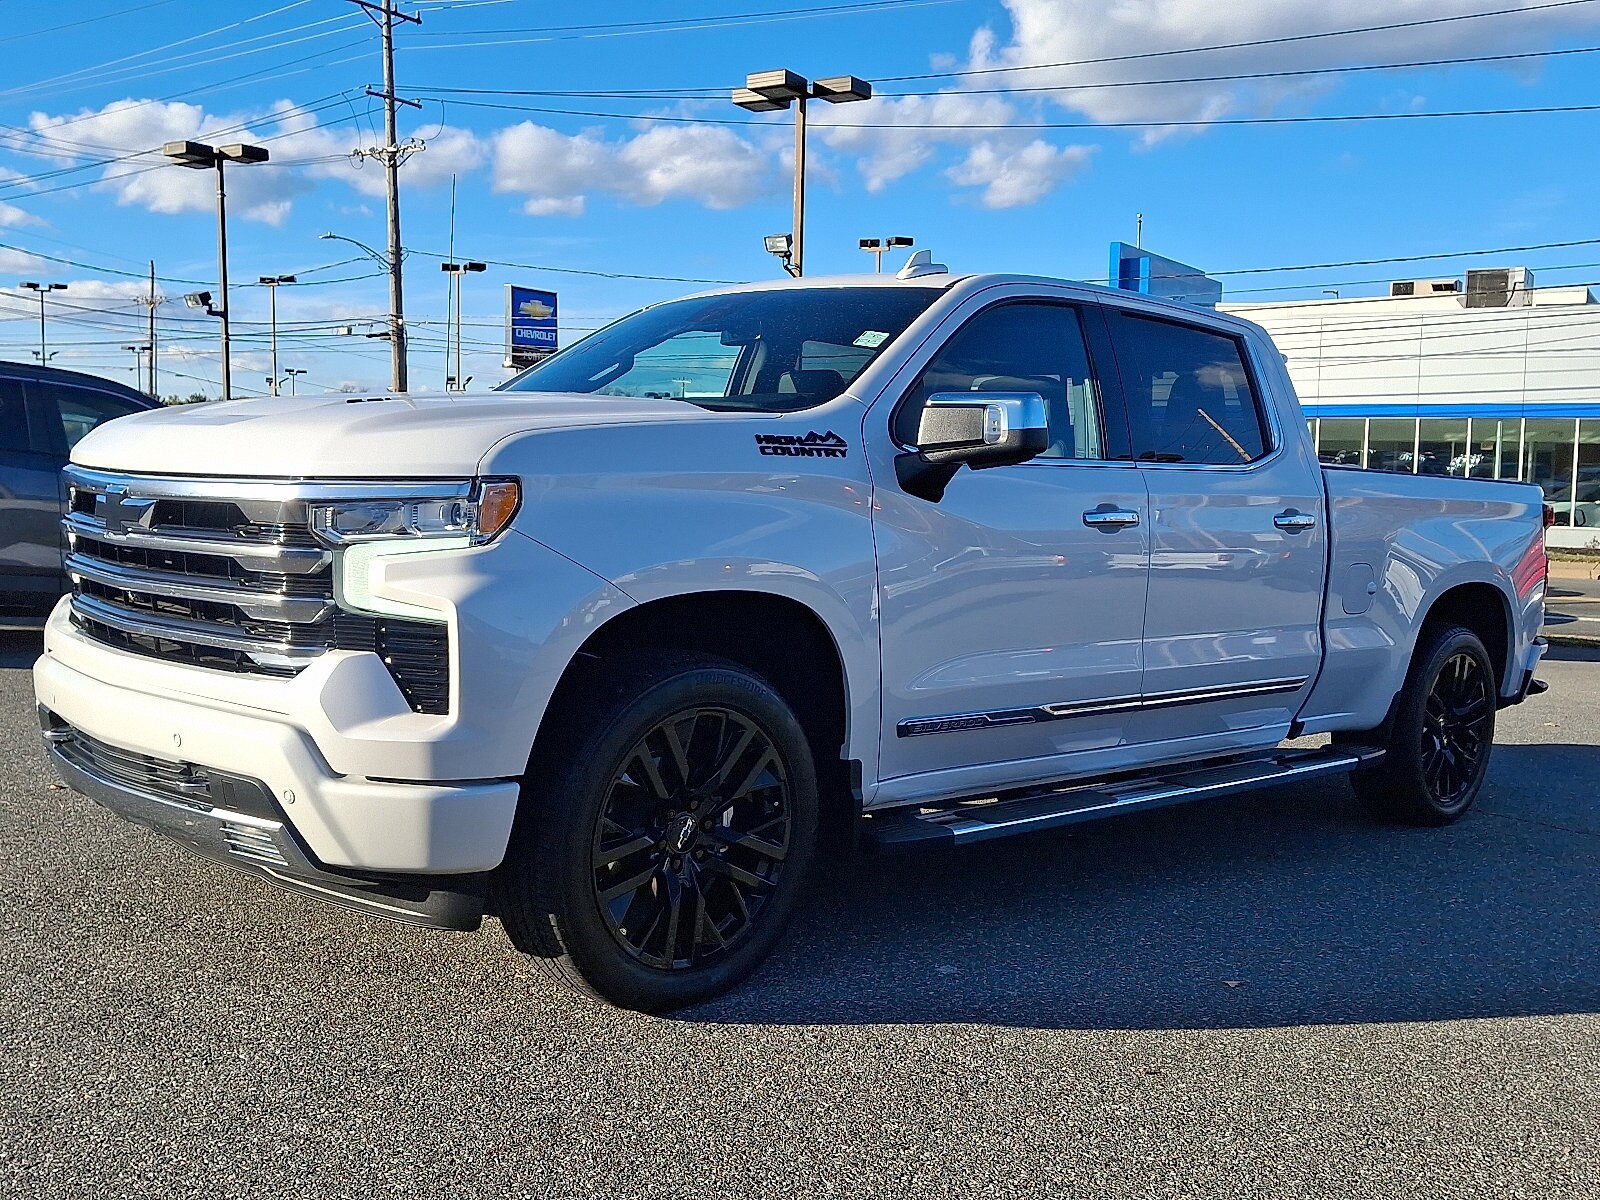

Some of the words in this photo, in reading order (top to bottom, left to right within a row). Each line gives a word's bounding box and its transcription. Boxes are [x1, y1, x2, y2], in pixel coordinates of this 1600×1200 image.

[515, 328, 556, 341] CHEVROLET
[754, 433, 803, 445] HIGH
[759, 446, 848, 457] COUNTRY
[913, 718, 985, 733] SILVERADO
